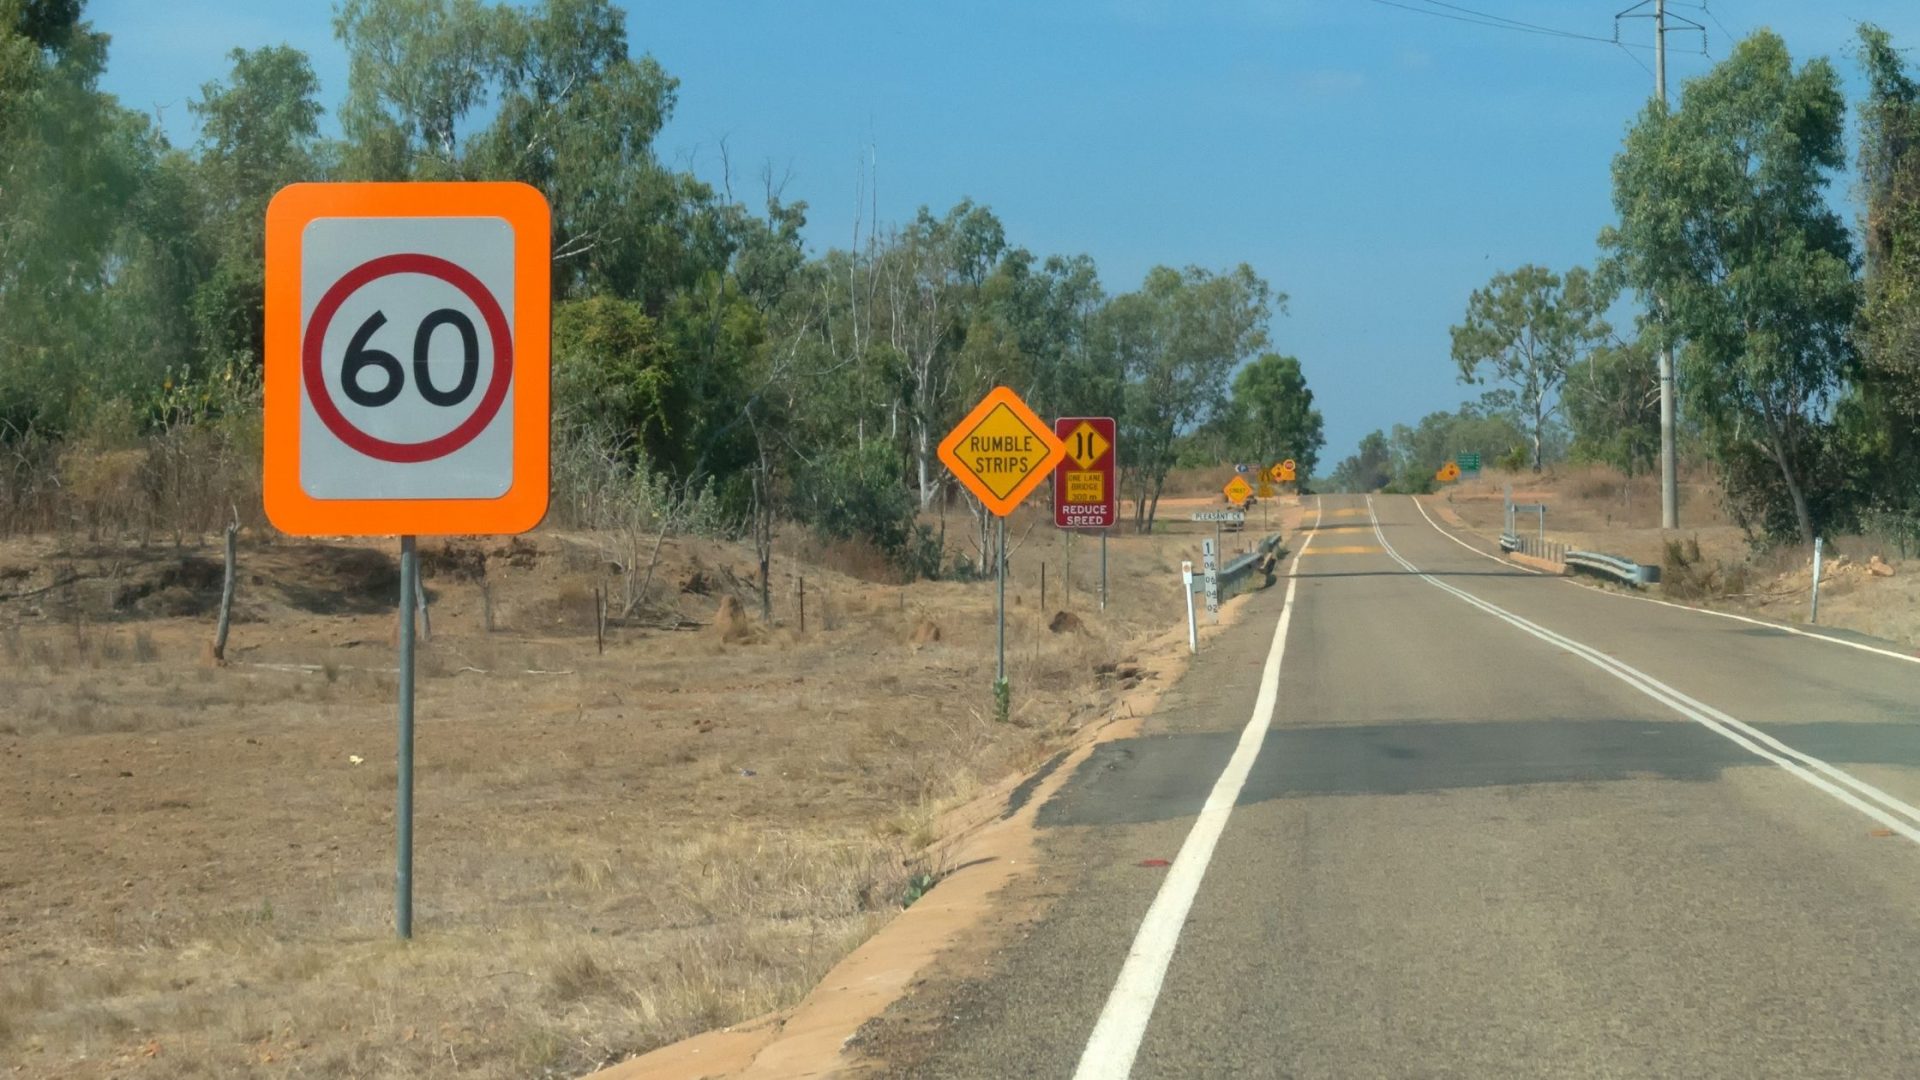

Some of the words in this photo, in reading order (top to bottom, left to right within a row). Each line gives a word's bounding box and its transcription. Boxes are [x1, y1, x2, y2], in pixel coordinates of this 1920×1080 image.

[341, 308, 479, 407] 60
[970, 436, 1032, 452] RUMBLE
[975, 457, 1028, 473] STRIPS
[1084, 474, 1101, 482] LANE
[1071, 483, 1098, 491] BRIDGE
[1062, 505, 1107, 514] REDUCE
[1066, 516, 1103, 525] SPEED
[1195, 512, 1228, 520] PLEASANT
[1205, 542, 1210, 554] 1
